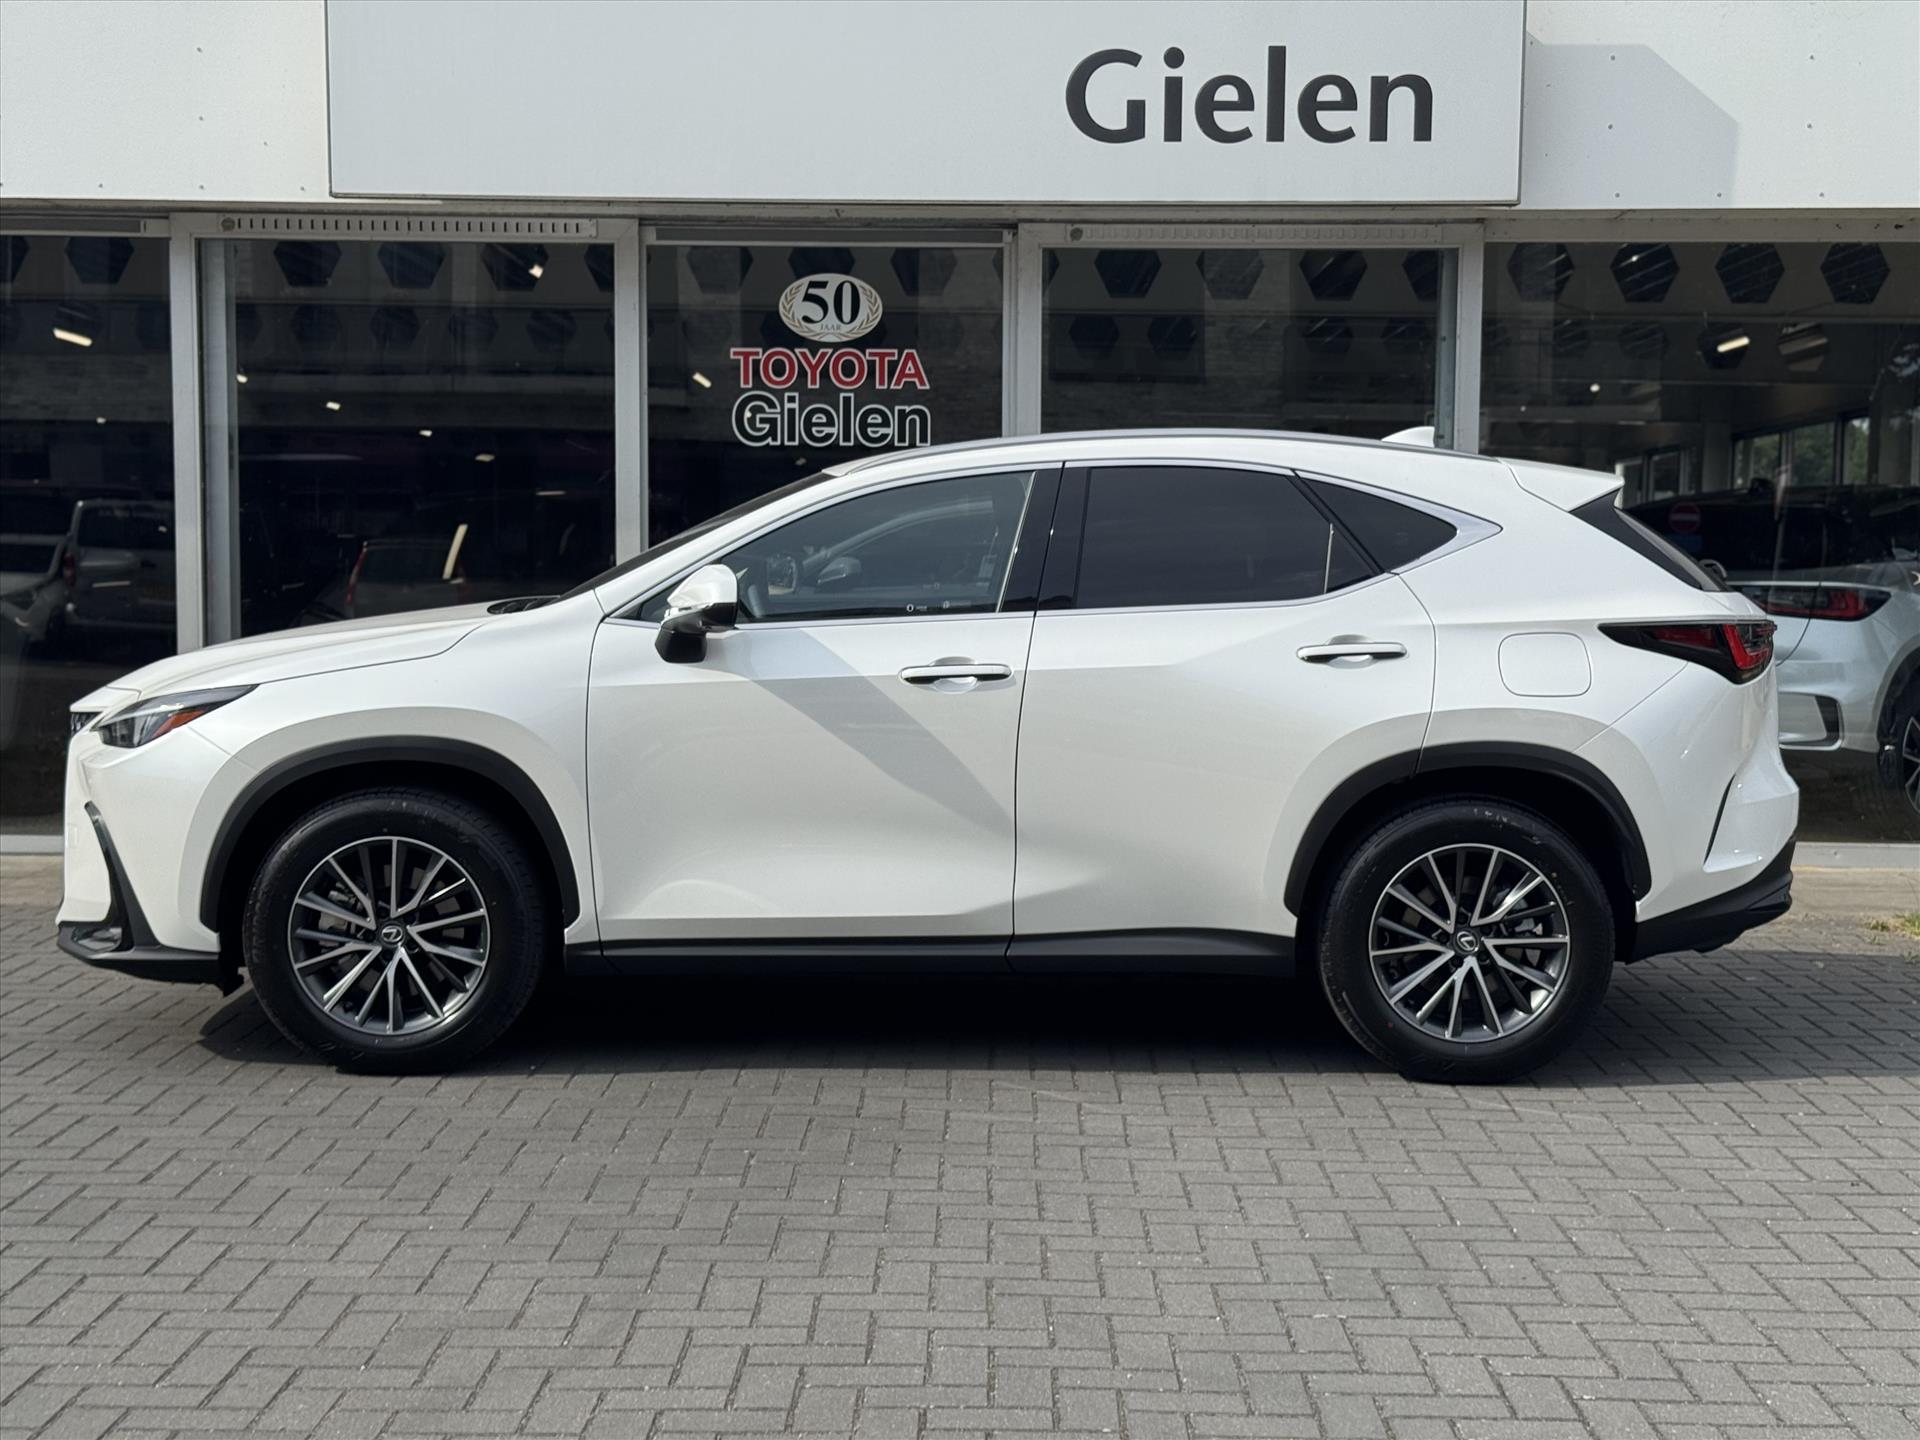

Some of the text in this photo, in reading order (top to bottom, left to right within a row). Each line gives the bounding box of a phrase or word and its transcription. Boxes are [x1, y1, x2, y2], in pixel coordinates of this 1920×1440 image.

[1065, 45, 1433, 144] Gielen
[801, 280, 861, 325] 50
[819, 323, 842, 331] JAAR
[730, 347, 930, 390] TOYOTA
[732, 390, 931, 447] Gielen
